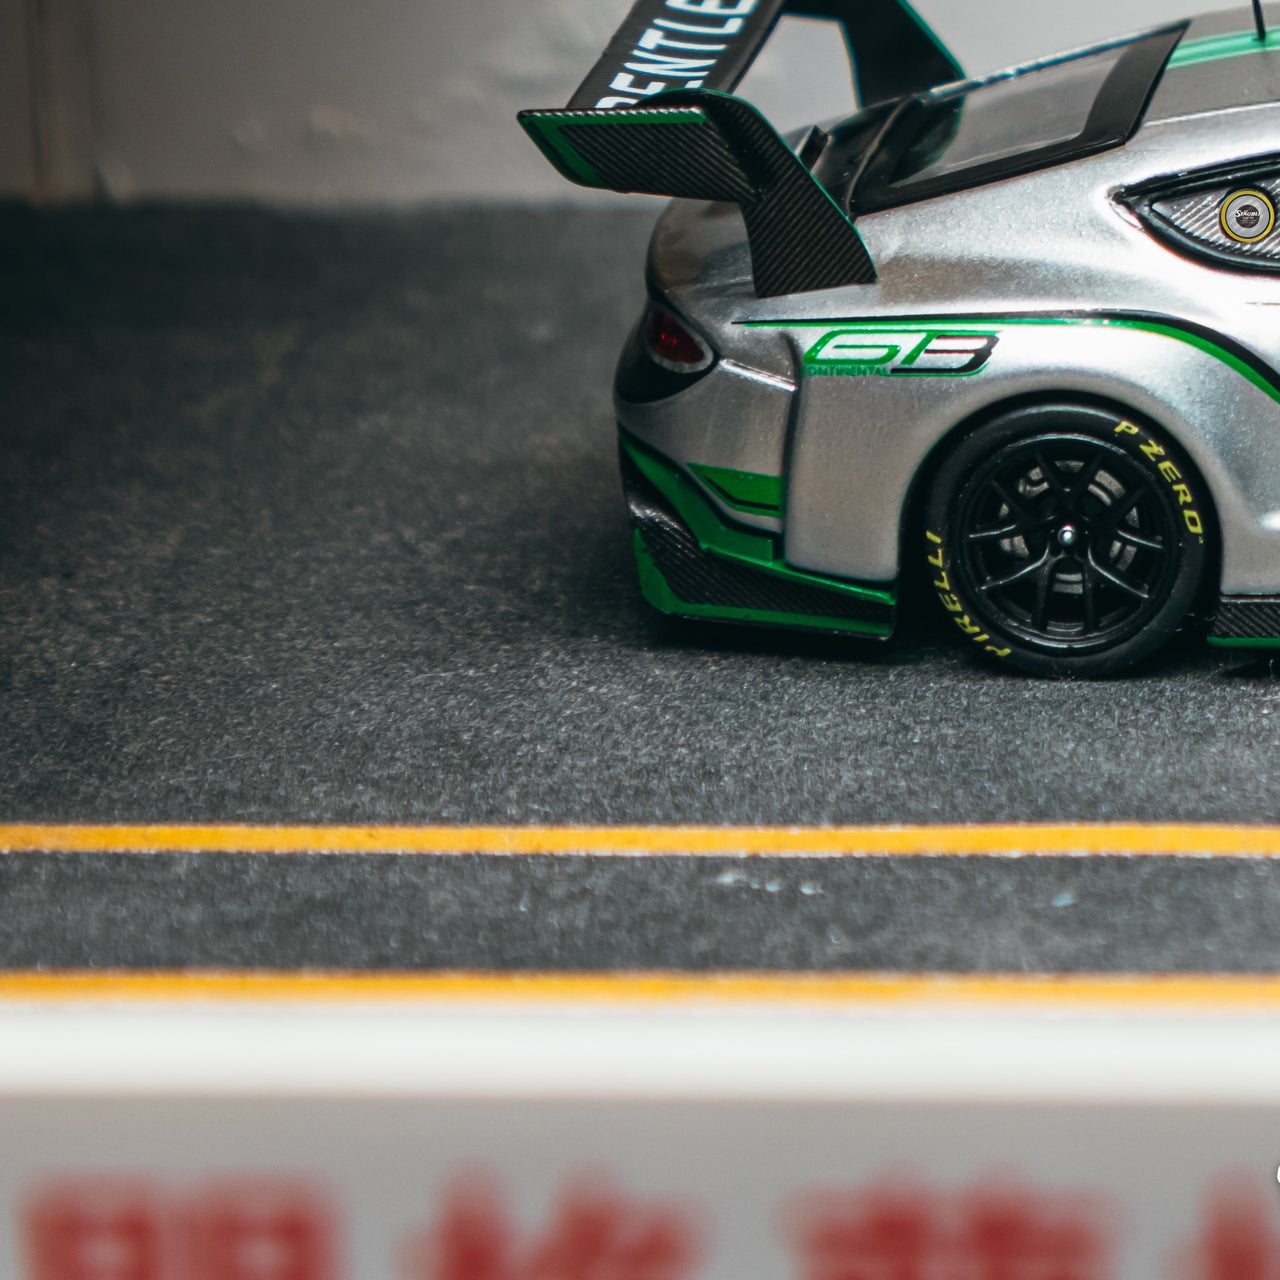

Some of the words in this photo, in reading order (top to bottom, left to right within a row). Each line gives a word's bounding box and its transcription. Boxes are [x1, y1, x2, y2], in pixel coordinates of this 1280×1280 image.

[803, 329, 1001, 378] GT3
[1114, 420, 1139, 436] P
[1139, 439, 1203, 536] ZERO
[925, 530, 1012, 657] PIRELLI
